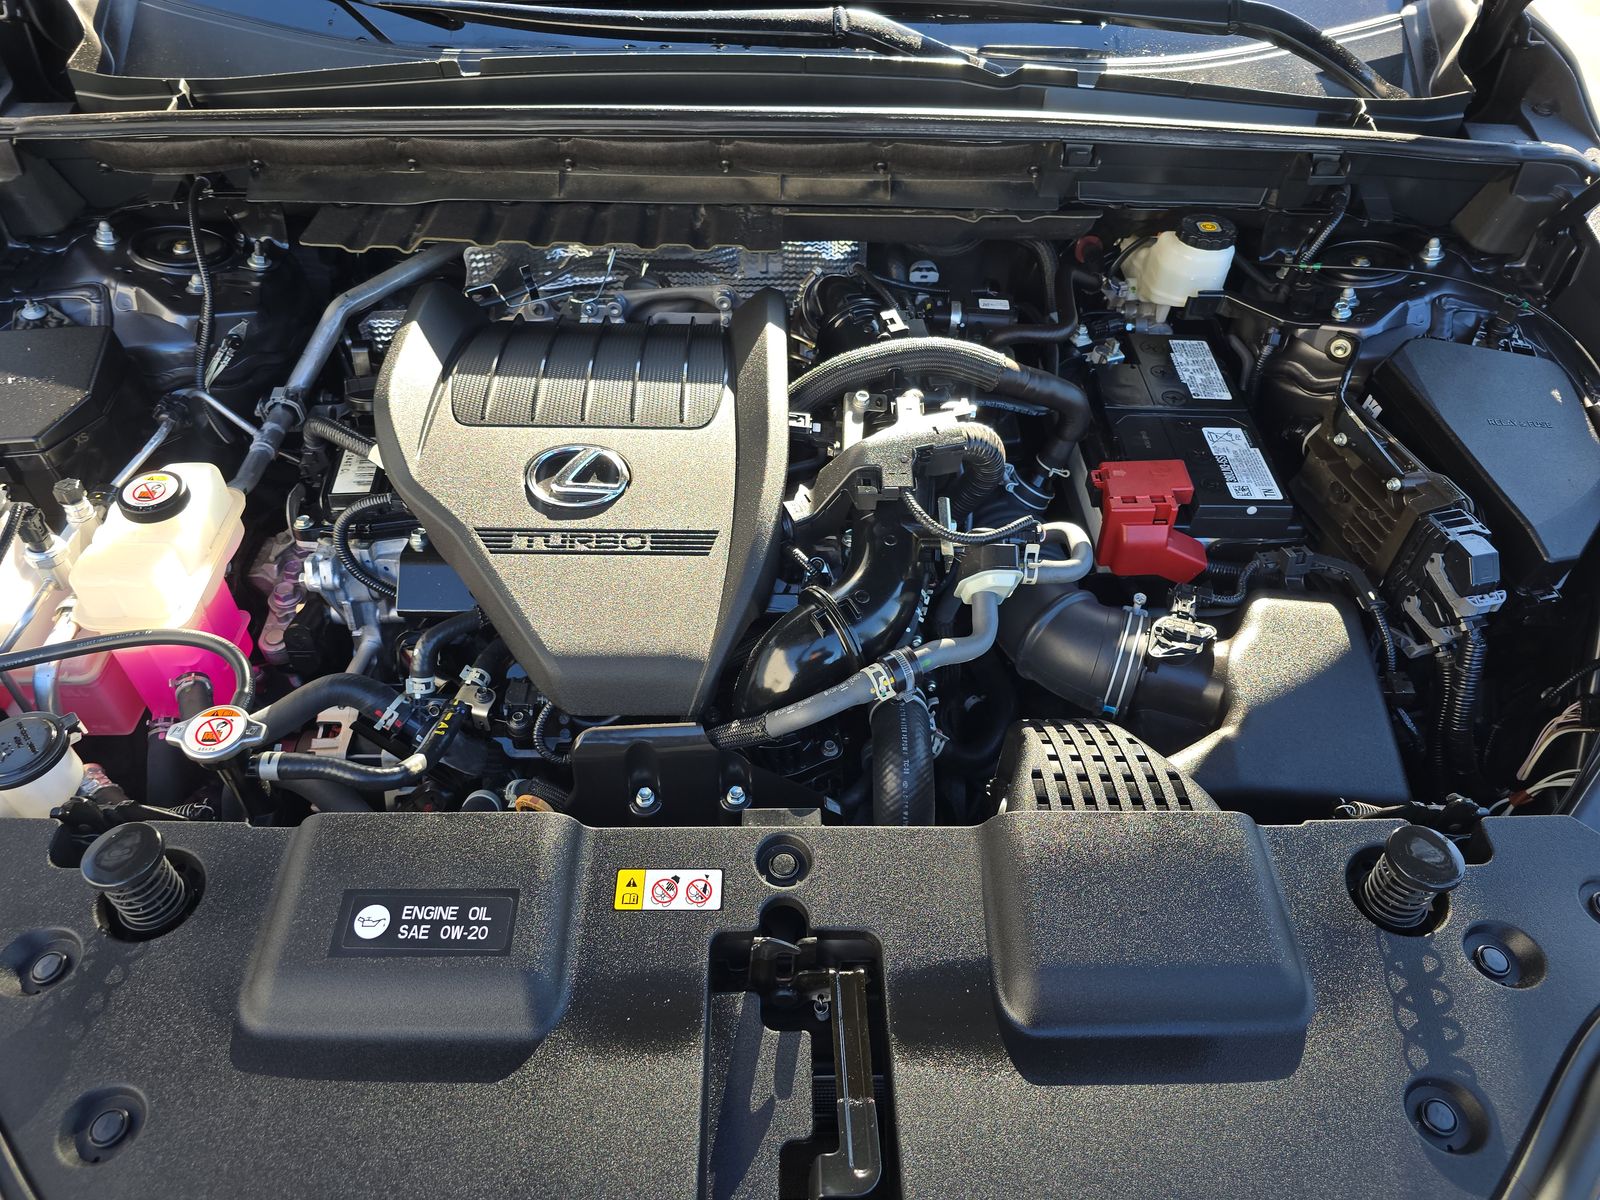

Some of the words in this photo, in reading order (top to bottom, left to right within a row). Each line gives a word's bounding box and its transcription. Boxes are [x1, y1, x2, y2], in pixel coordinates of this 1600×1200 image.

[1486, 418, 1517, 427] RELAY
[1527, 420, 1553, 429] FUSE
[515, 532, 650, 550] TURBO
[401, 905, 459, 921] ENGINE
[468, 906, 492, 921] OIL
[397, 924, 431, 940] SAE
[439, 925, 489, 940] 0W-20
